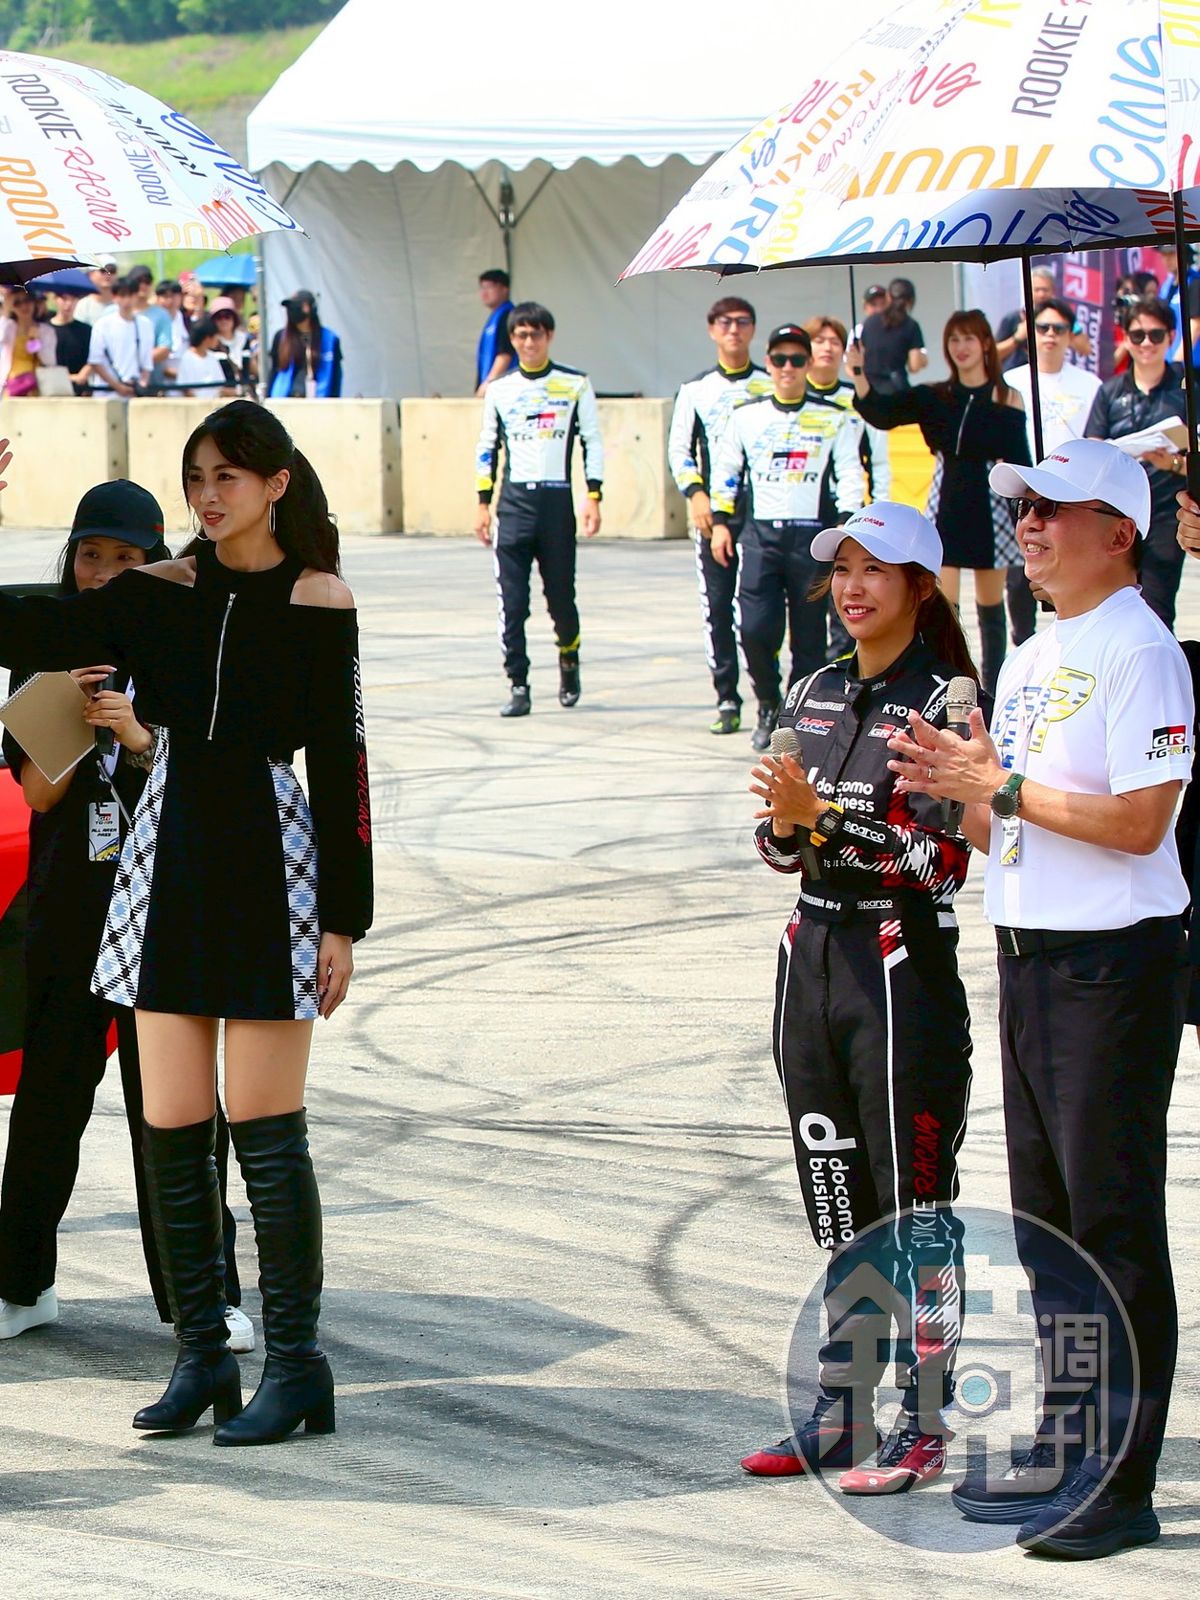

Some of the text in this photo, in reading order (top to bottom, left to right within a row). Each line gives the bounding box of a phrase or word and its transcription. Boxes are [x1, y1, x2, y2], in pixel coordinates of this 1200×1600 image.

[1011, 12, 1088, 118] ROOKIE
[0, 72, 132, 242] ROOKIE RACING
[768, 68, 877, 185] ROOKI
[352, 656, 367, 744] ROOKIE
[1152, 728, 1187, 749] GR
[842, 820, 886, 844] sparco
[856, 899, 894, 910] sparco
[912, 1109, 942, 1195] RACING
[809, 1158, 835, 1249] business
[828, 1158, 855, 1243] docomo
